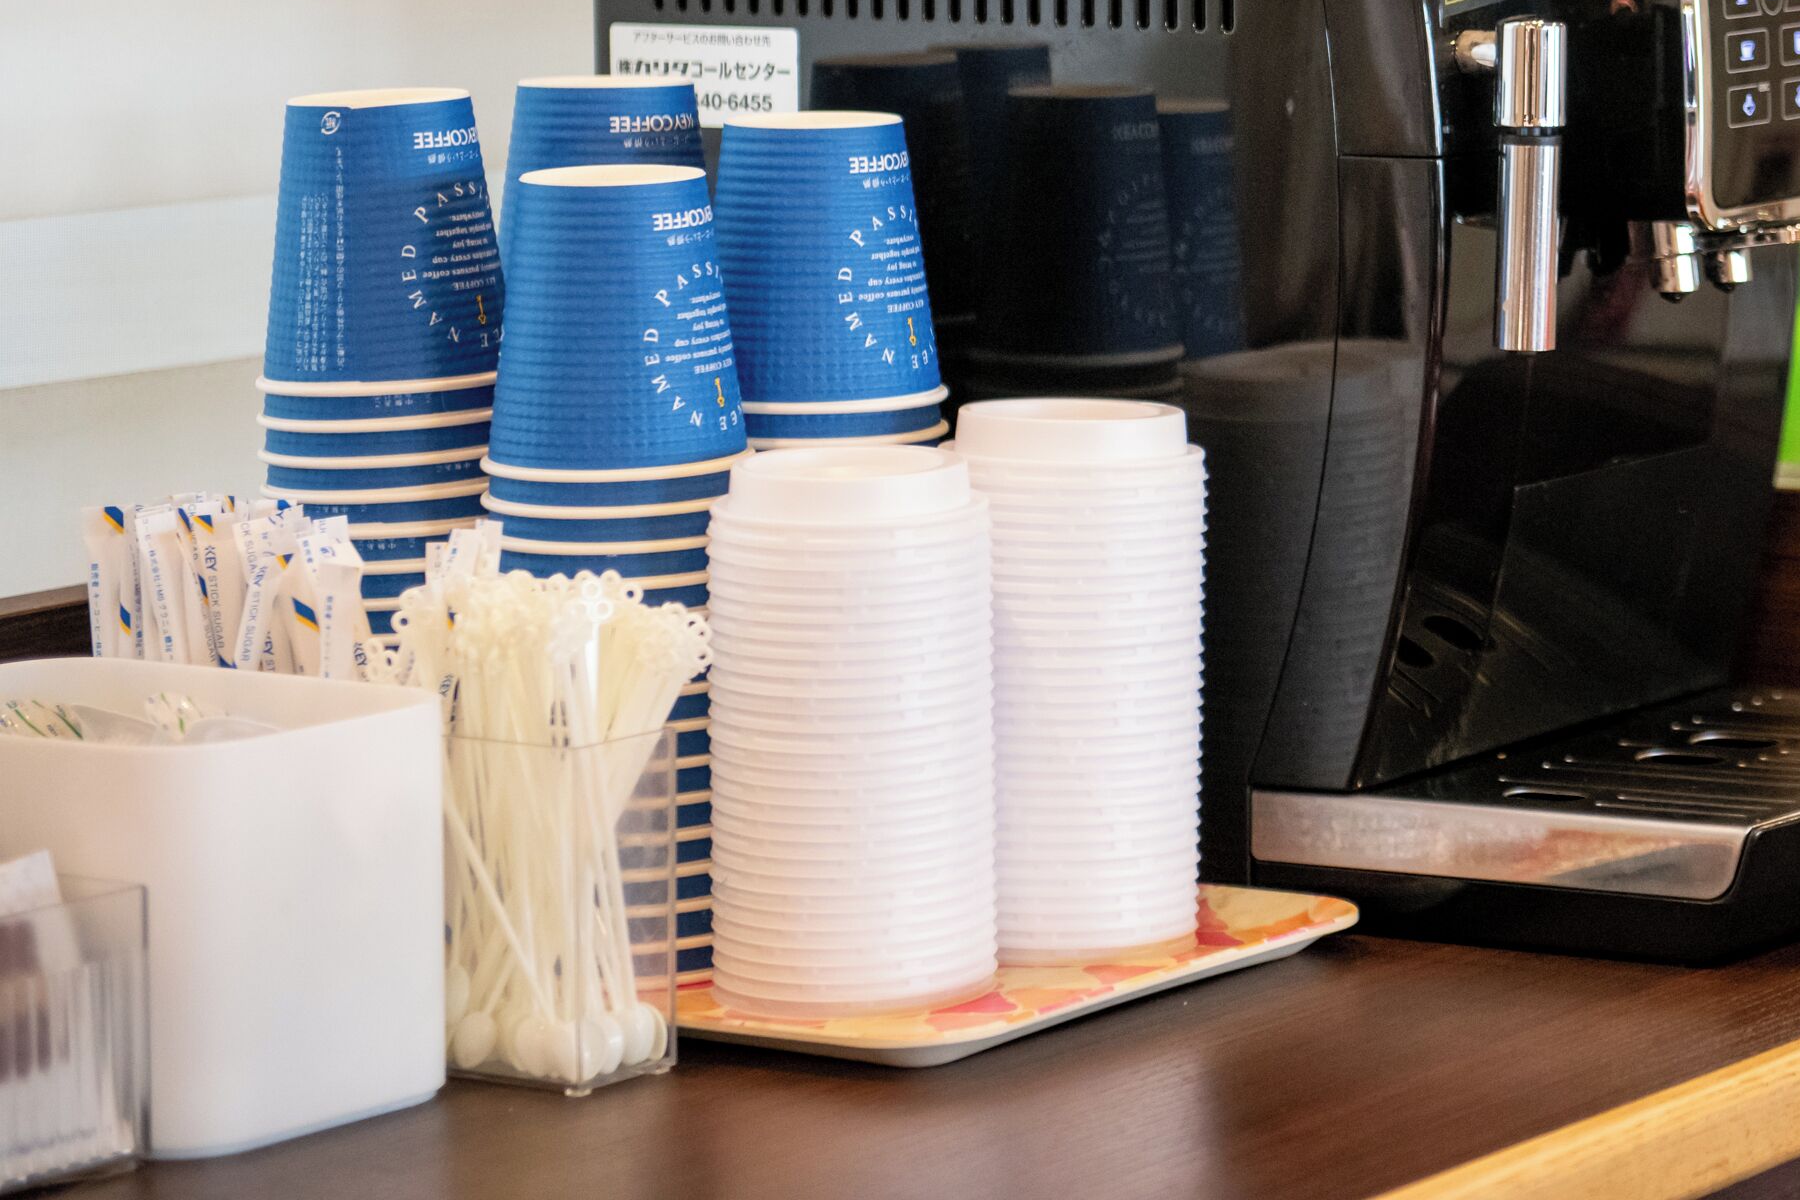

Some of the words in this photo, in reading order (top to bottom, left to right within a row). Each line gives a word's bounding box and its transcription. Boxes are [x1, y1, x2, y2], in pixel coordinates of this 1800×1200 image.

[431, 255, 448, 265] cup
[422, 269, 450, 280] coffee
[867, 278, 883, 287] cup
[858, 292, 885, 303] coffee
[204, 545, 217, 572] KEY
[207, 575, 220, 607] STICK
[247, 591, 261, 622] STICK
[212, 610, 225, 650] SUGAR
[239, 625, 255, 662] SUGAR
